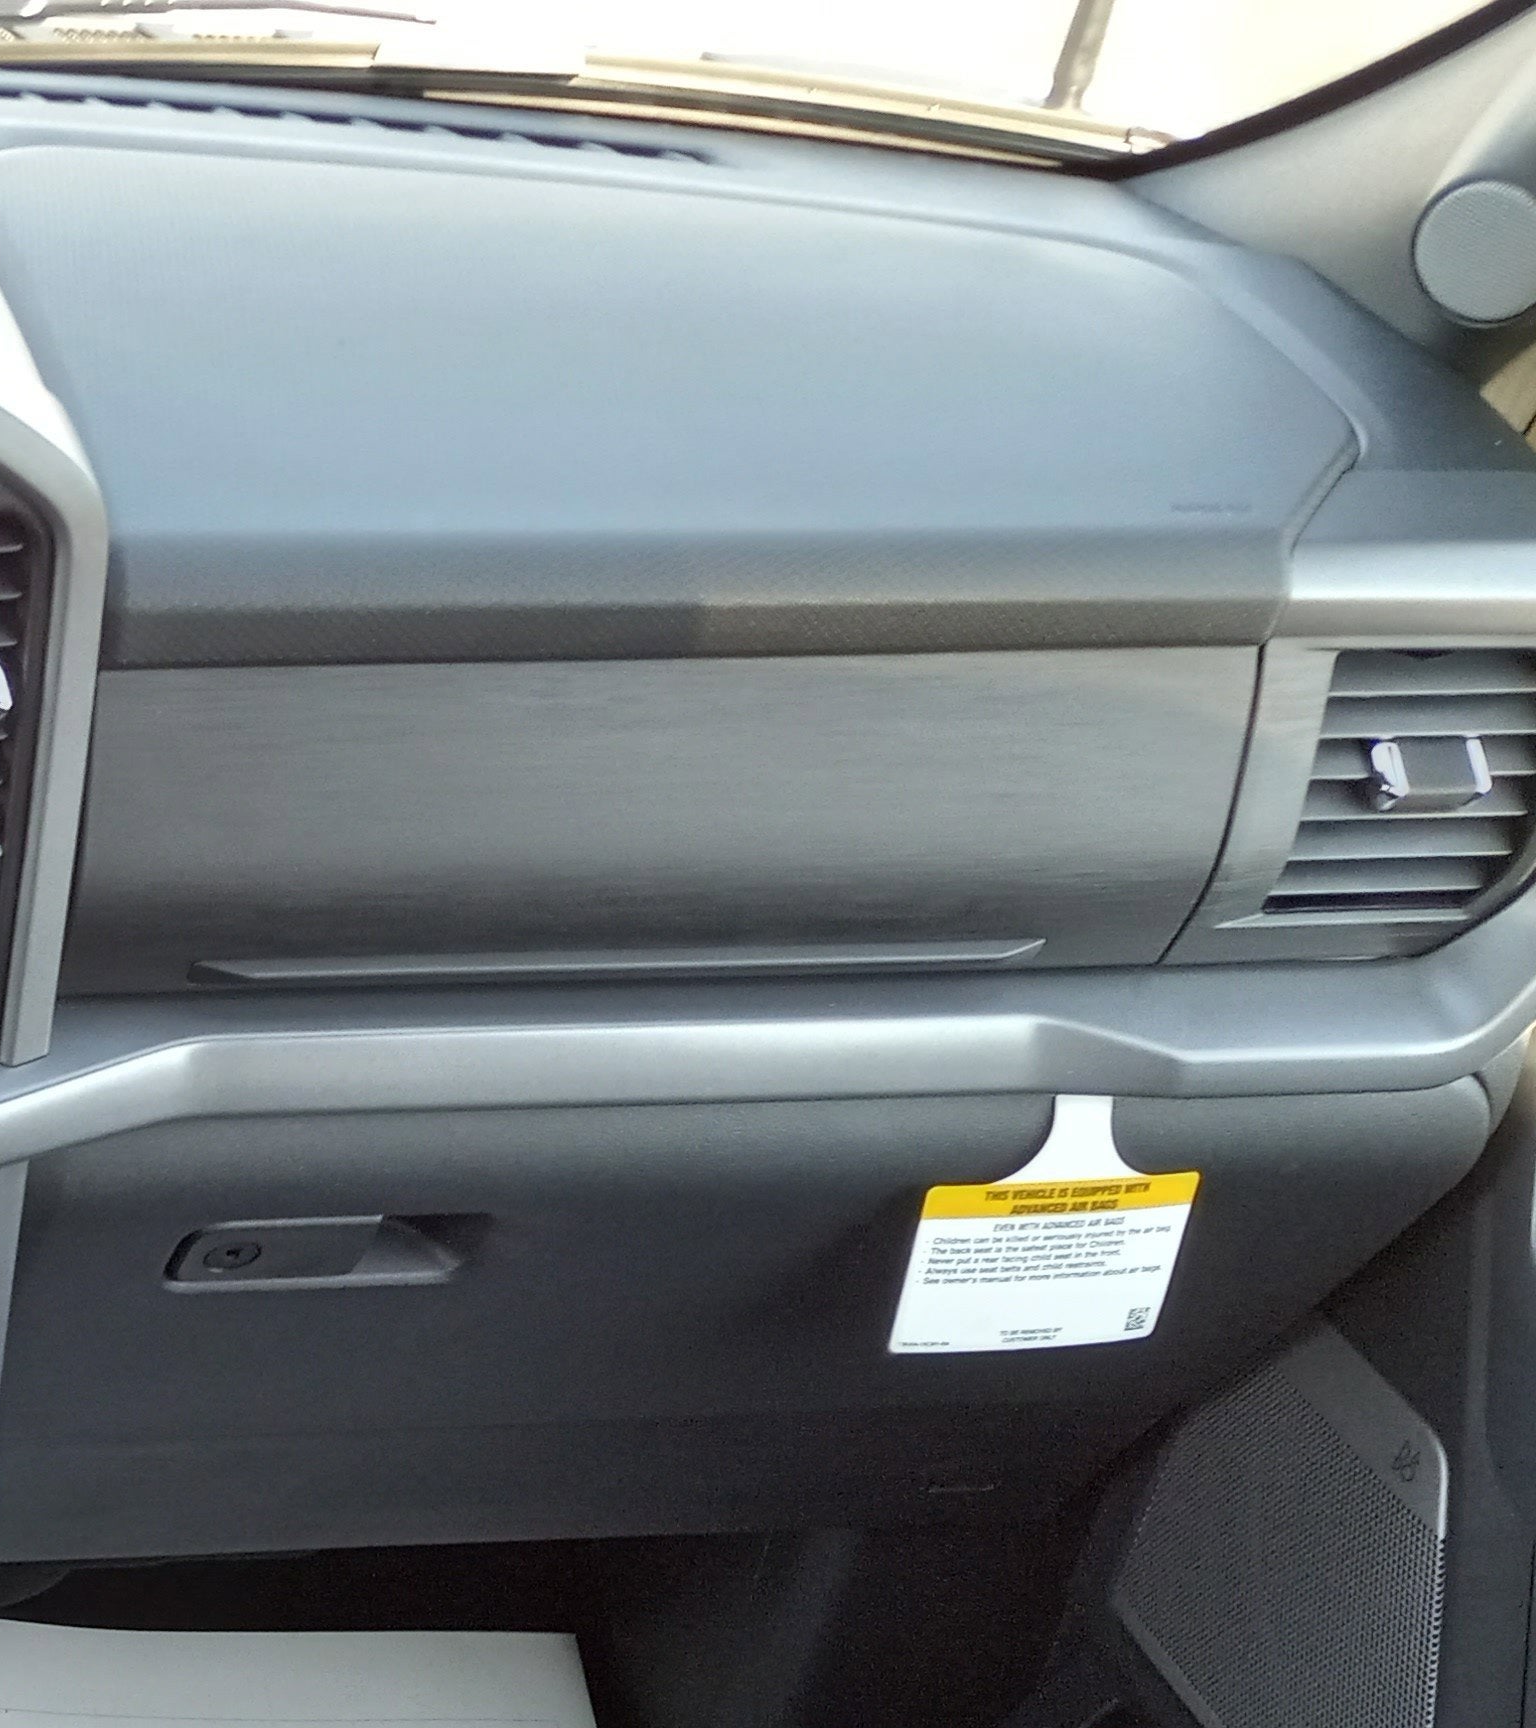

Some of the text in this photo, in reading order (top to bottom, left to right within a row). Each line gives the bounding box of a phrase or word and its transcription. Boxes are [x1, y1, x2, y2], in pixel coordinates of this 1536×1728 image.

[985, 1190, 1009, 1201] THIS
[1012, 1187, 1057, 1200] VEHICLE
[1071, 1184, 1122, 1198] EQUIPPED
[1124, 1181, 1151, 1194] WITH
[1011, 1199, 1119, 1215] ADVANCED AIR BAGS
